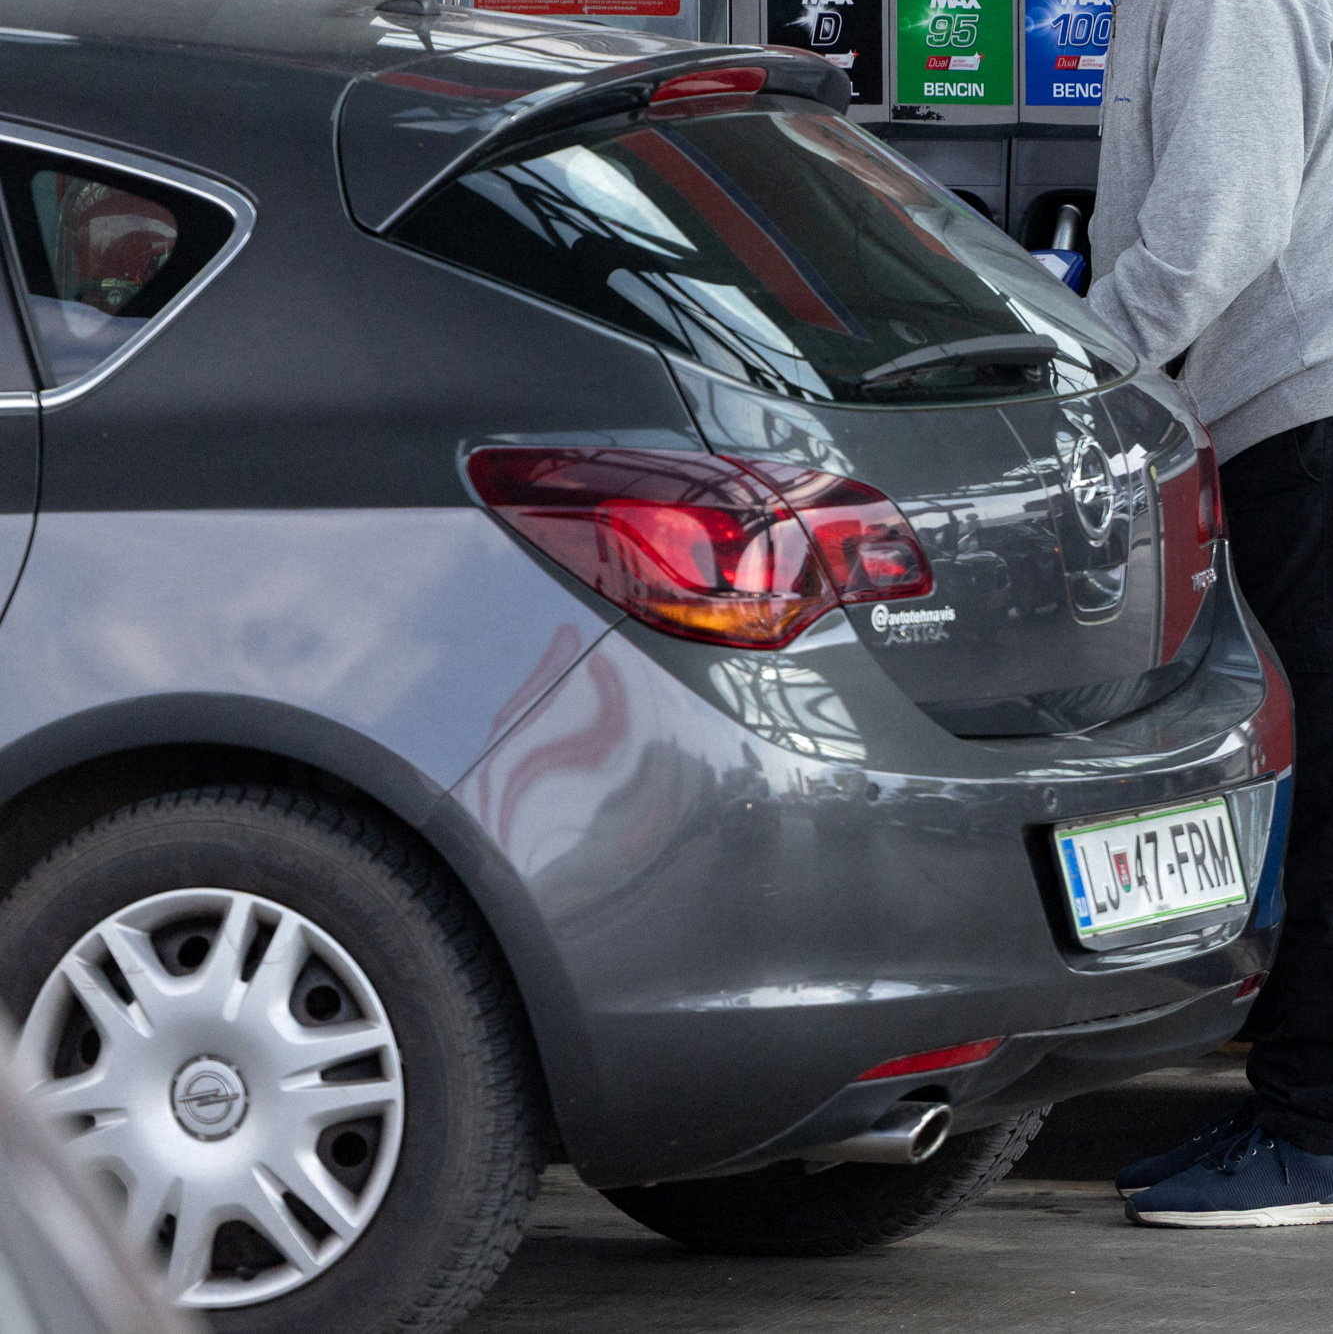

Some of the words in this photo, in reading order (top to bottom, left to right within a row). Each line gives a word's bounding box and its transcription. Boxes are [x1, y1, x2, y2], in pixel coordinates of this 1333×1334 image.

[810, 11, 842, 46] D
[926, 13, 979, 48] 95
[1050, 11, 1112, 47] 100
[928, 58, 948, 68] Dual
[1057, 57, 1078, 67] Dual
[924, 82, 985, 97] BENCIN
[1053, 82, 1102, 98] BENC
[1080, 840, 1120, 914] LJ
[1134, 816, 1236, 903] 47-FRM
